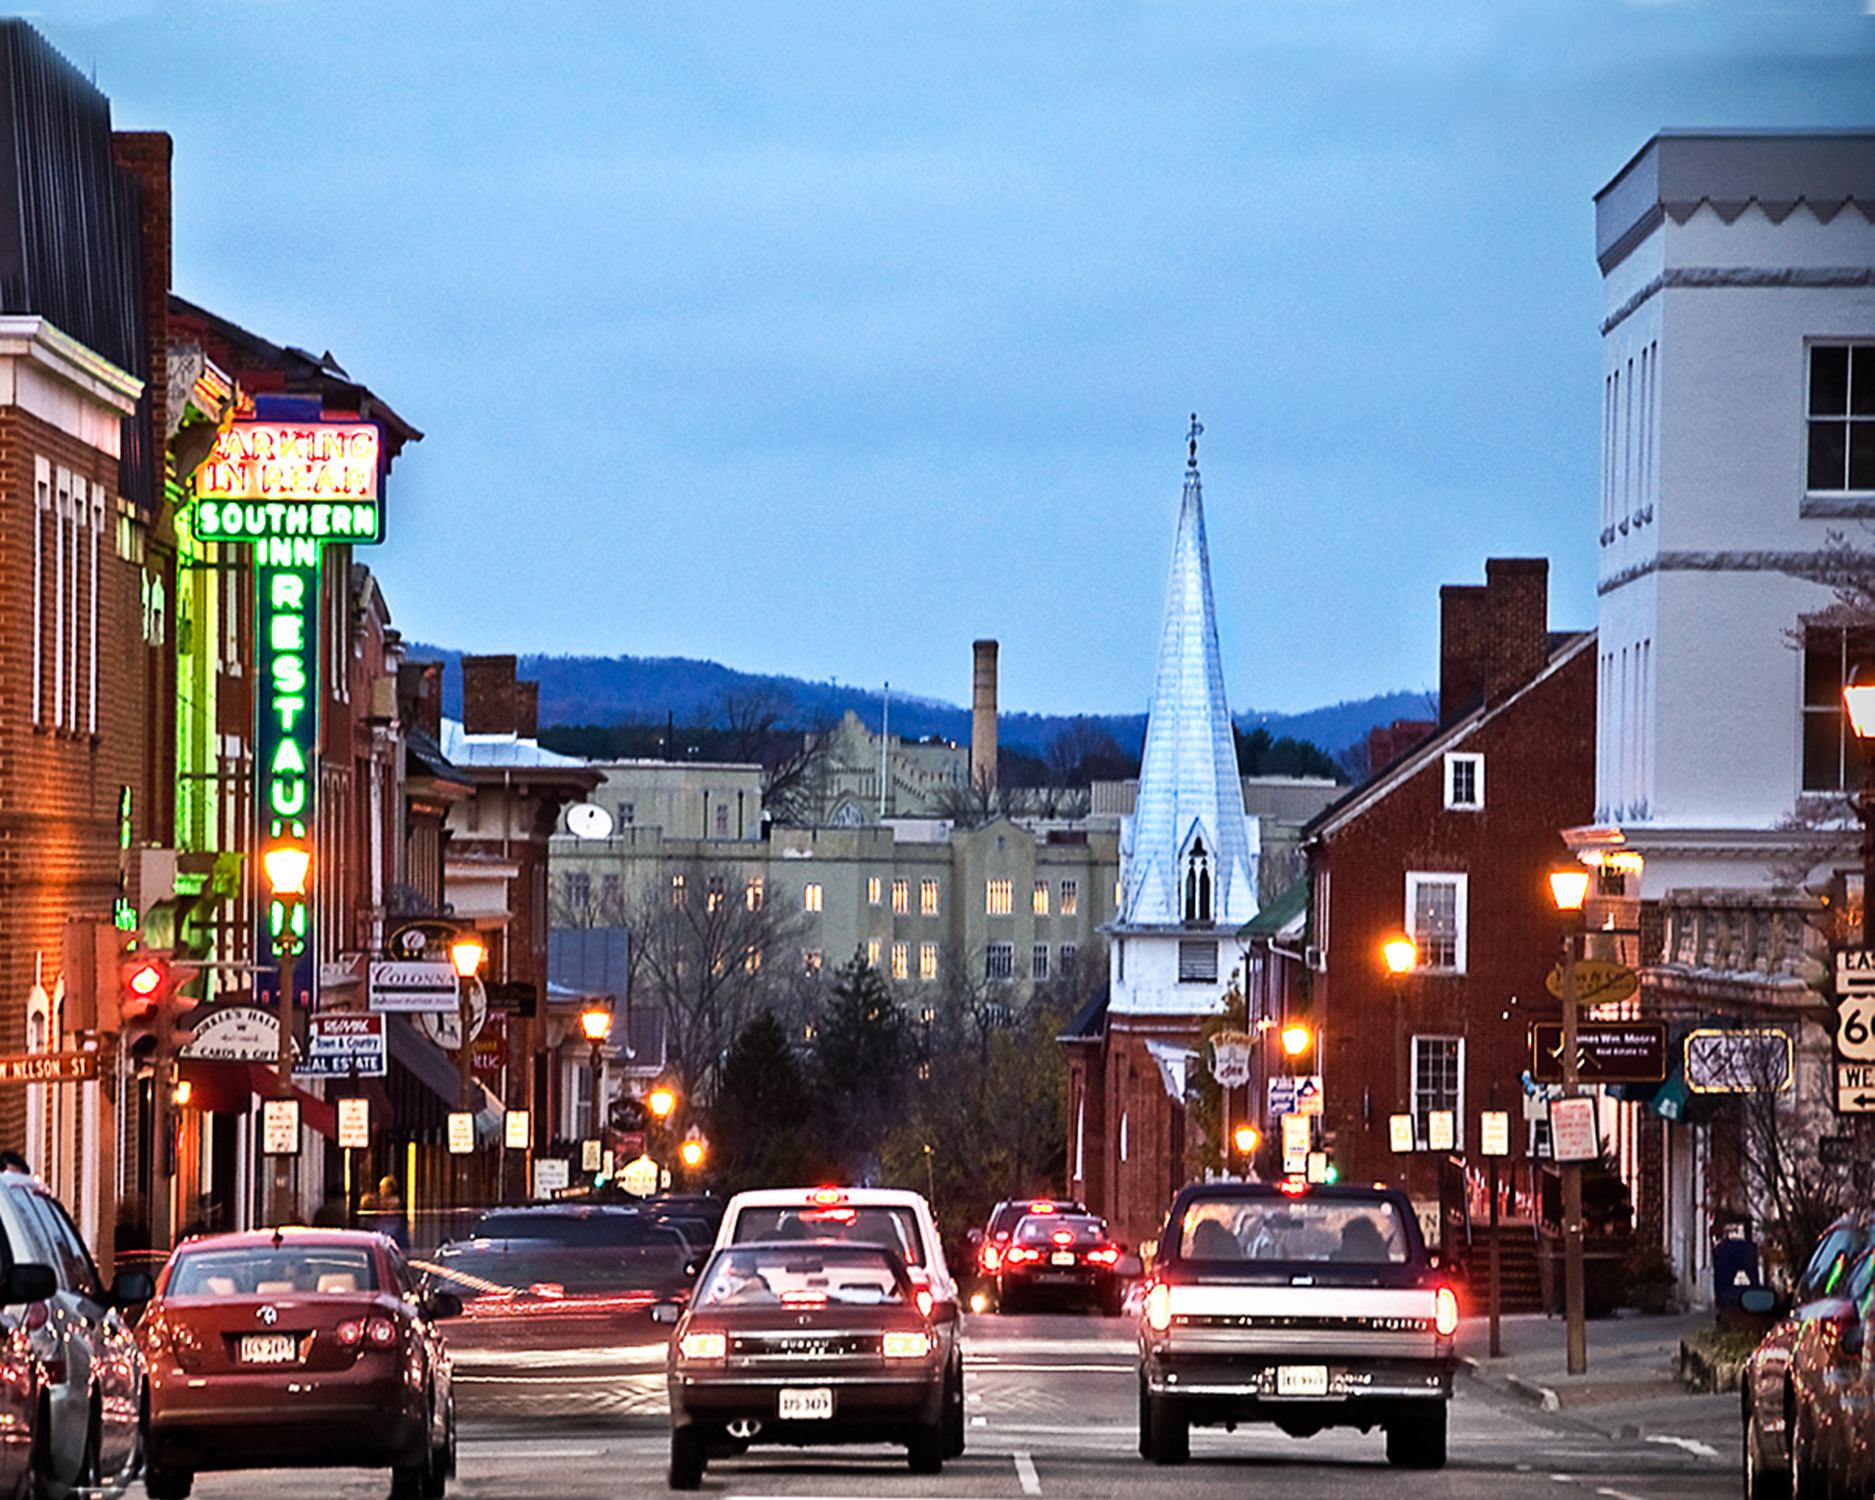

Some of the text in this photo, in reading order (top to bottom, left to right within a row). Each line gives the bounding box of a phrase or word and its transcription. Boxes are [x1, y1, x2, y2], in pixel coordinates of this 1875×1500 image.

[217, 428, 374, 460] ARKING
[207, 462, 368, 494] IN REAR
[200, 502, 375, 536] SOUTHERN
[257, 536, 316, 568] INN
[324, 1020, 369, 1033] RE/MAX
[13, 1059, 60, 1079] NELSON
[71, 1057, 86, 1076] ST
